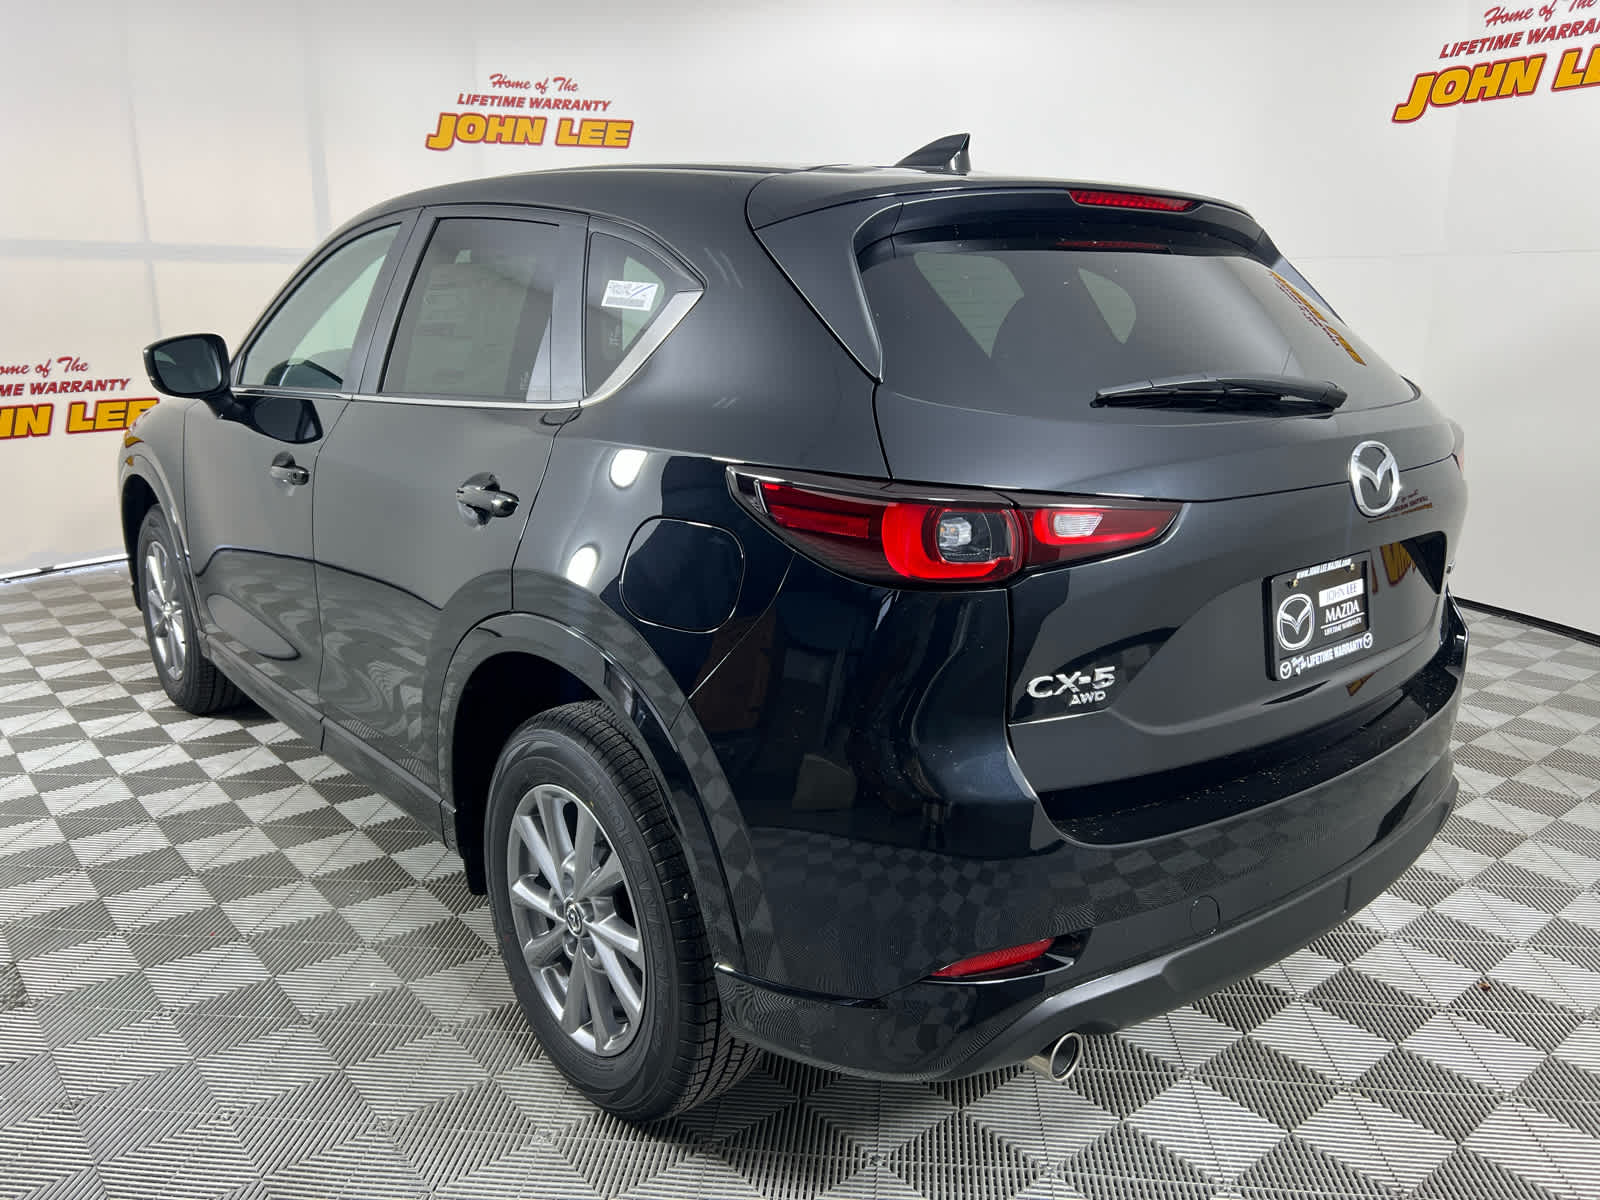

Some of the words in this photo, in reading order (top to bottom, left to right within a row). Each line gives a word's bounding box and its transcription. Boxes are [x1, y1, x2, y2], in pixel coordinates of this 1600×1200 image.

[1483, 6, 1534, 28] Home
[1538, 0, 1556, 22] of
[1439, 31, 1525, 59] LIFETIME
[1526, 18, 1600, 45] WARRA
[489, 73, 531, 89] Home
[534, 77, 549, 94] of
[553, 76, 578, 92] The
[1391, 53, 1547, 124] JOHN
[456, 93, 526, 108] LIFETIME
[528, 96, 611, 112] WARRANTY
[425, 112, 548, 151] JOHN
[555, 117, 634, 148] LEE
[0, 364, 30, 375] ome
[34, 358, 51, 378] of
[57, 356, 89, 373] The
[30, 378, 131, 395] WARRANTY
[1325, 599, 1360, 624] MAZDA
[1306, 648, 1334, 668] LIFETIME
[1334, 637, 1364, 658] WARRANTY
[1027, 666, 1116, 698] CX-5
[1069, 690, 1106, 706] AWD
